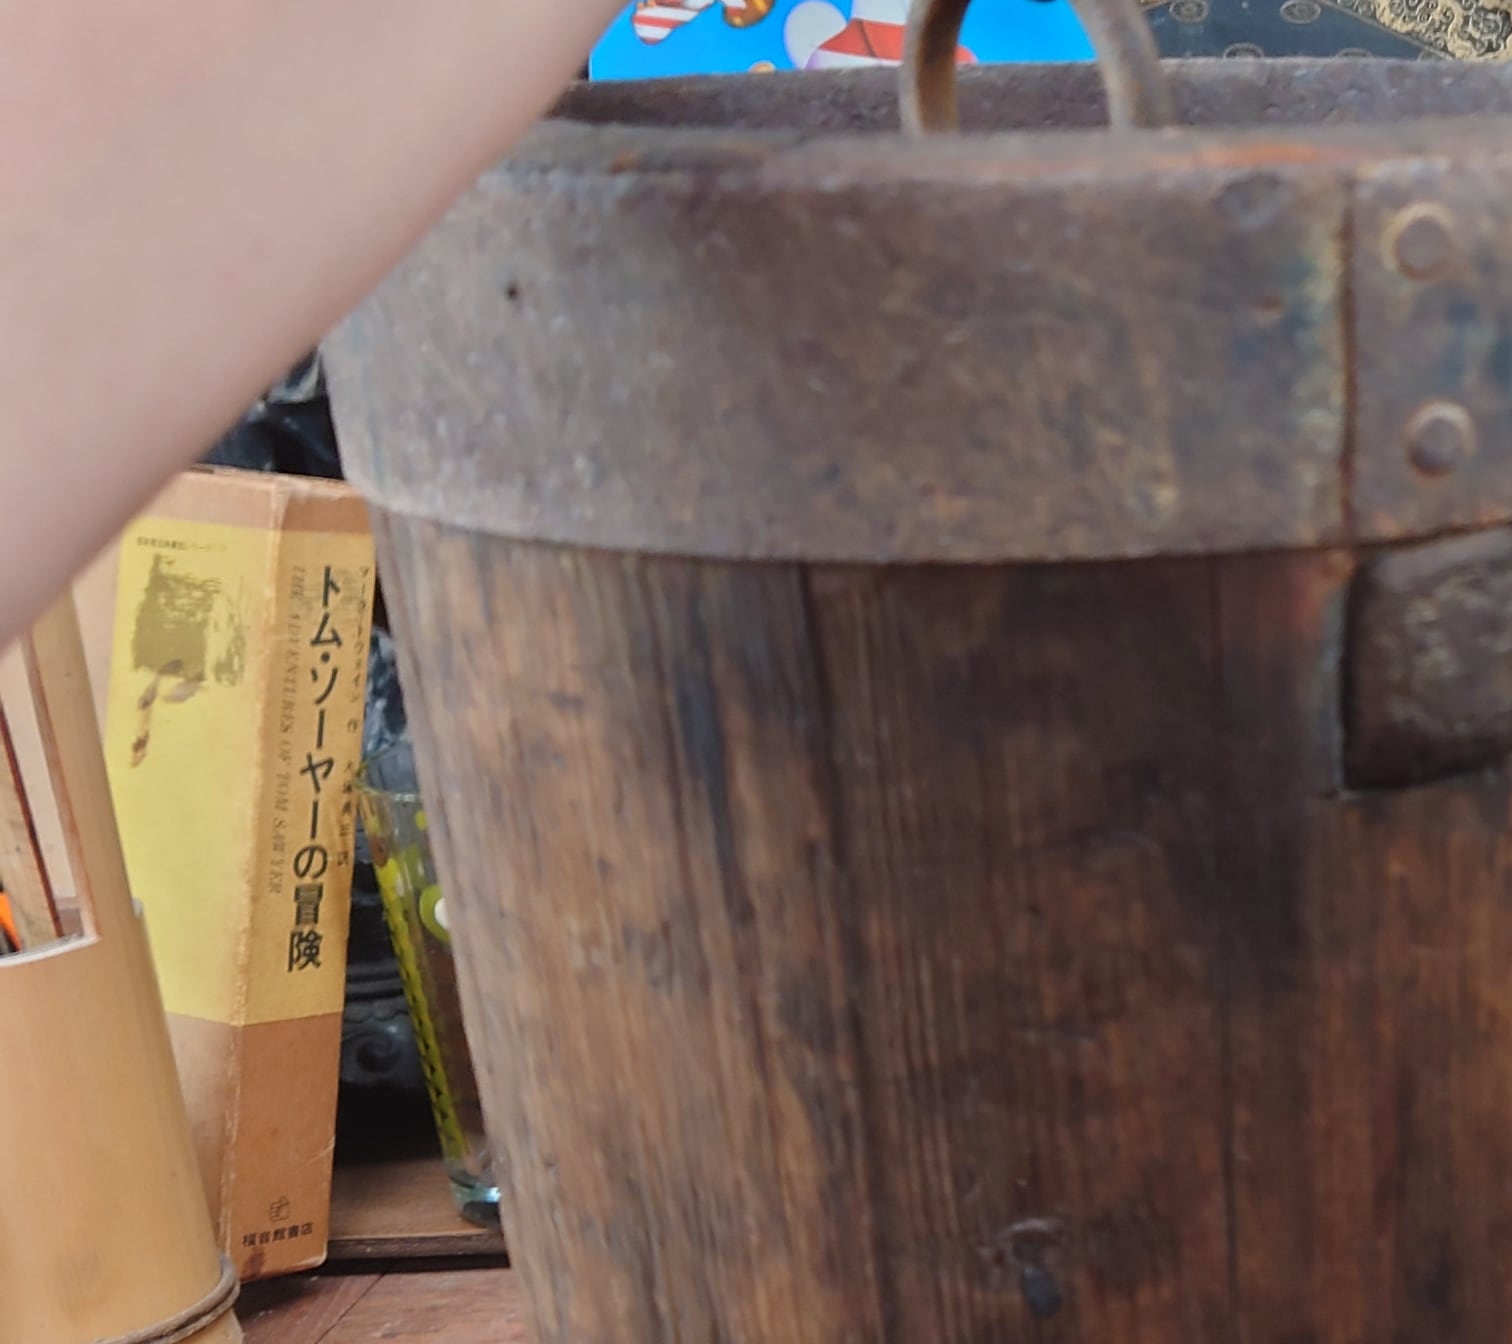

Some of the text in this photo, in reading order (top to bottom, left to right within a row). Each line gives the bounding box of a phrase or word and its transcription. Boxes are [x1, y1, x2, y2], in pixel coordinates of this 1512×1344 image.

[287, 565, 342, 972] トム・ソーヤーの冒険
